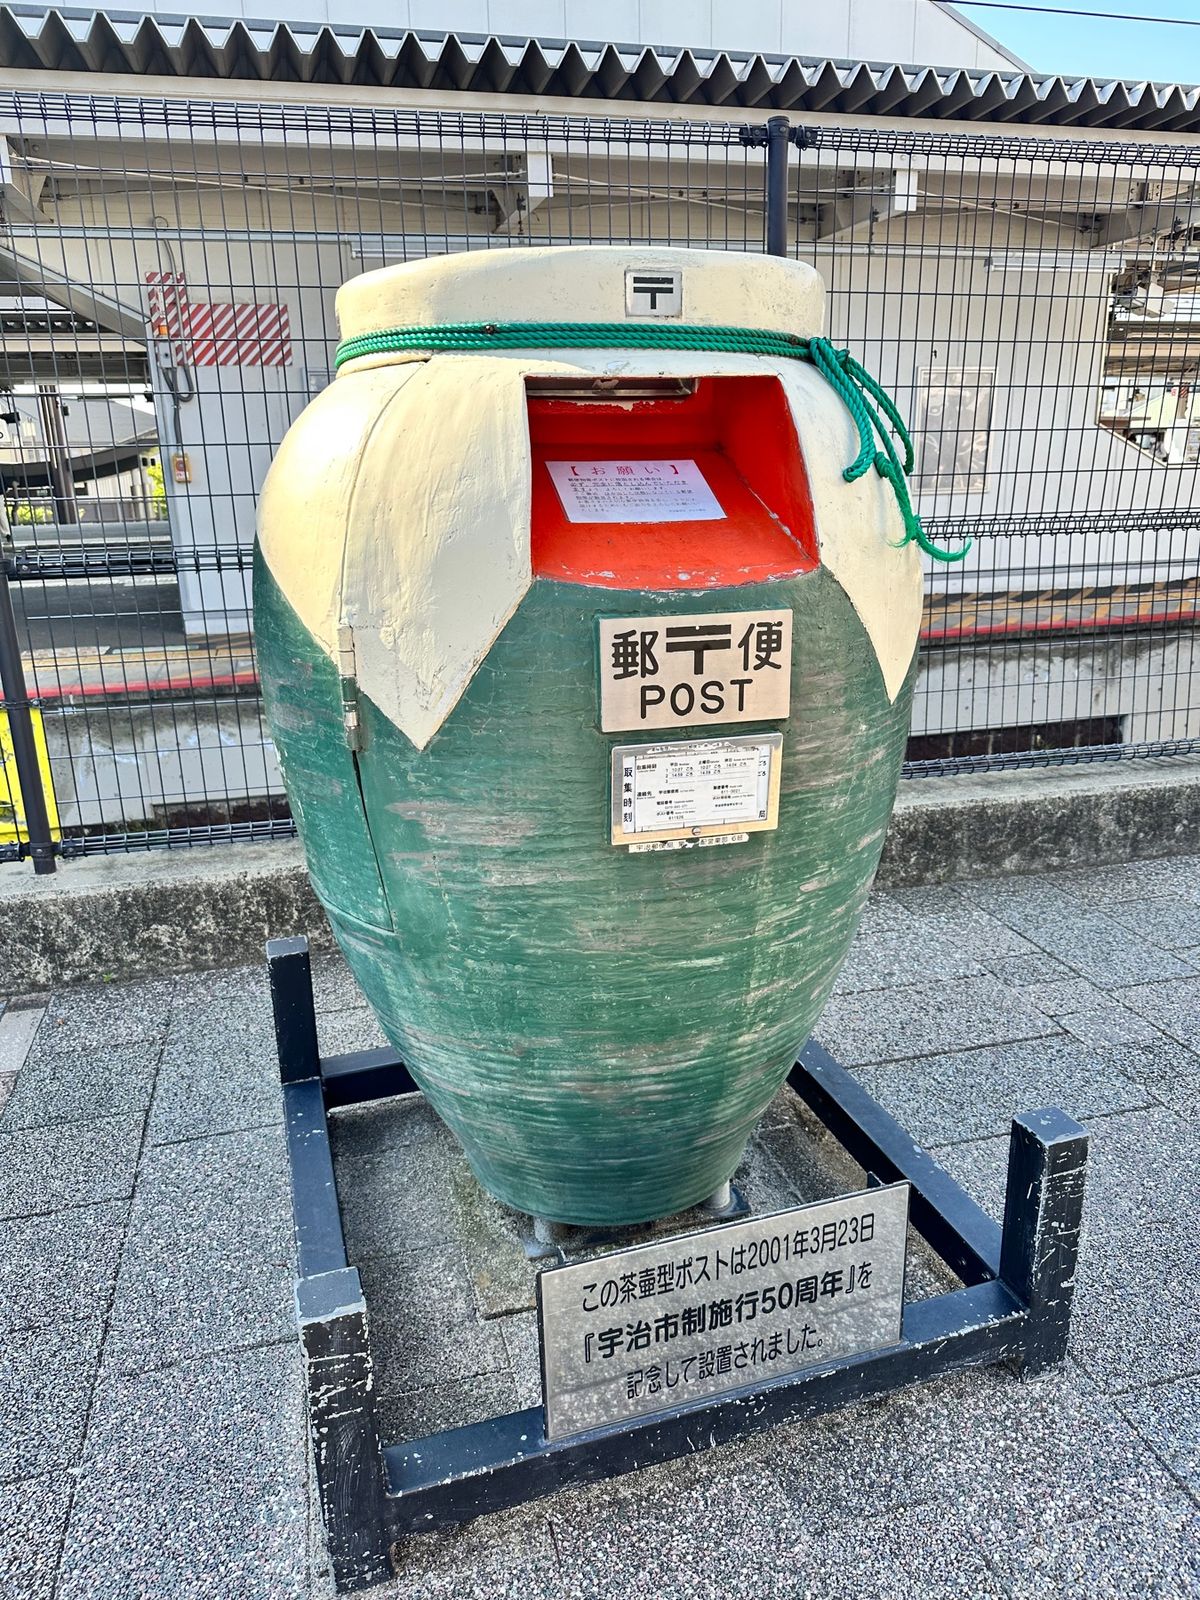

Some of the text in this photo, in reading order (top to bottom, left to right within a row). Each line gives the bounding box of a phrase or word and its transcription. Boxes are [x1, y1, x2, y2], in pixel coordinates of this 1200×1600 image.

[640, 678, 753, 720] POST
[623, 766, 633, 823] 取集時刻
[584, 1261, 873, 1363] 『宇治市制施行50周年』を
[626, 1323, 824, 1400] 記念して設置されました。
